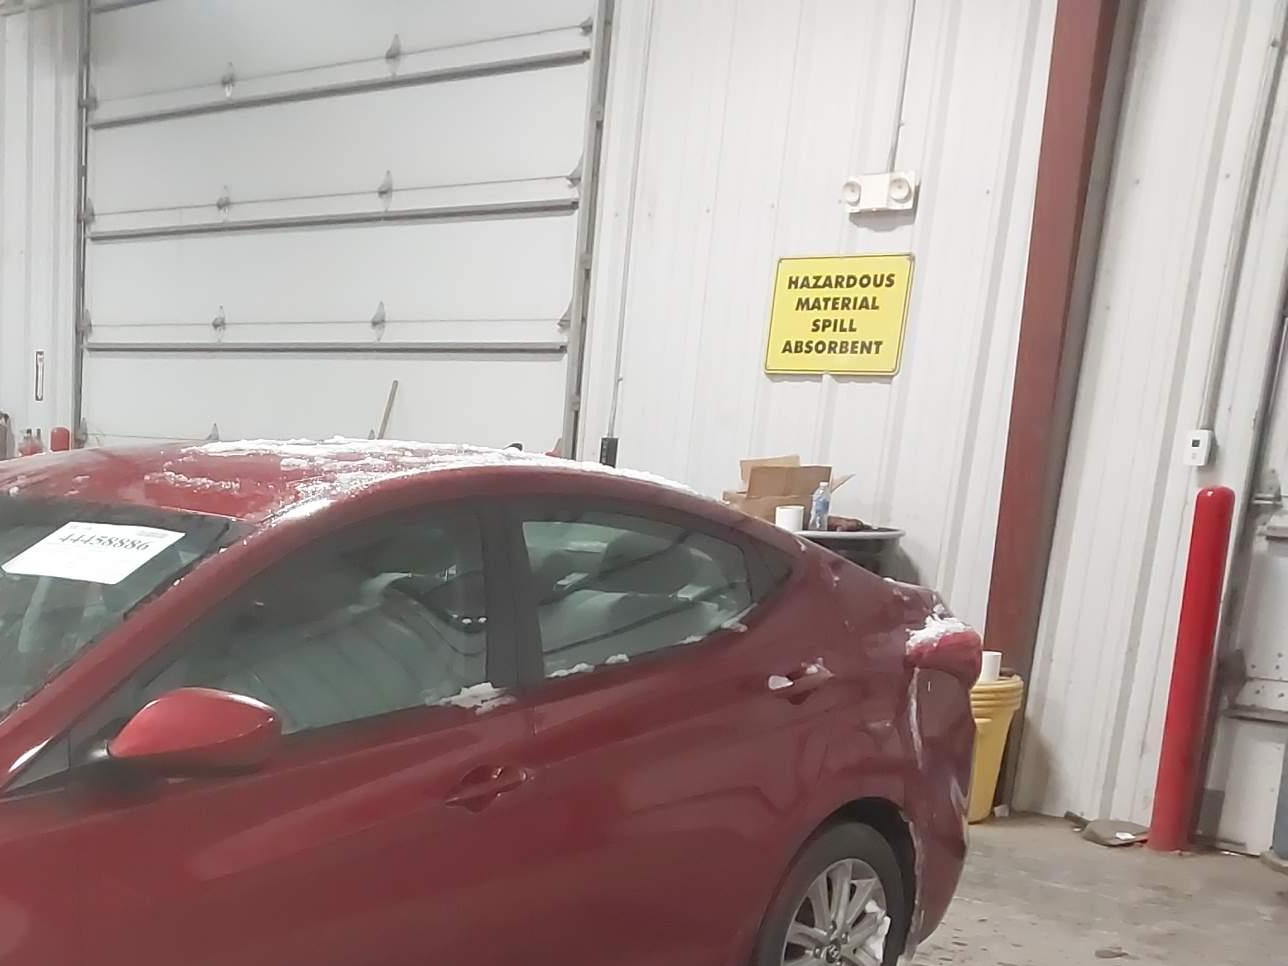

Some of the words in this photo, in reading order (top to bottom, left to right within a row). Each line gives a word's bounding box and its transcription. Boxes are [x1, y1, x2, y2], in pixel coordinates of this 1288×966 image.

[787, 273, 896, 289] HAZARDOUS
[795, 296, 880, 311] MATERIAL
[811, 319, 857, 333] SPILL
[781, 340, 883, 355] ABSORBENT
[59, 533, 152, 551] 44458886
